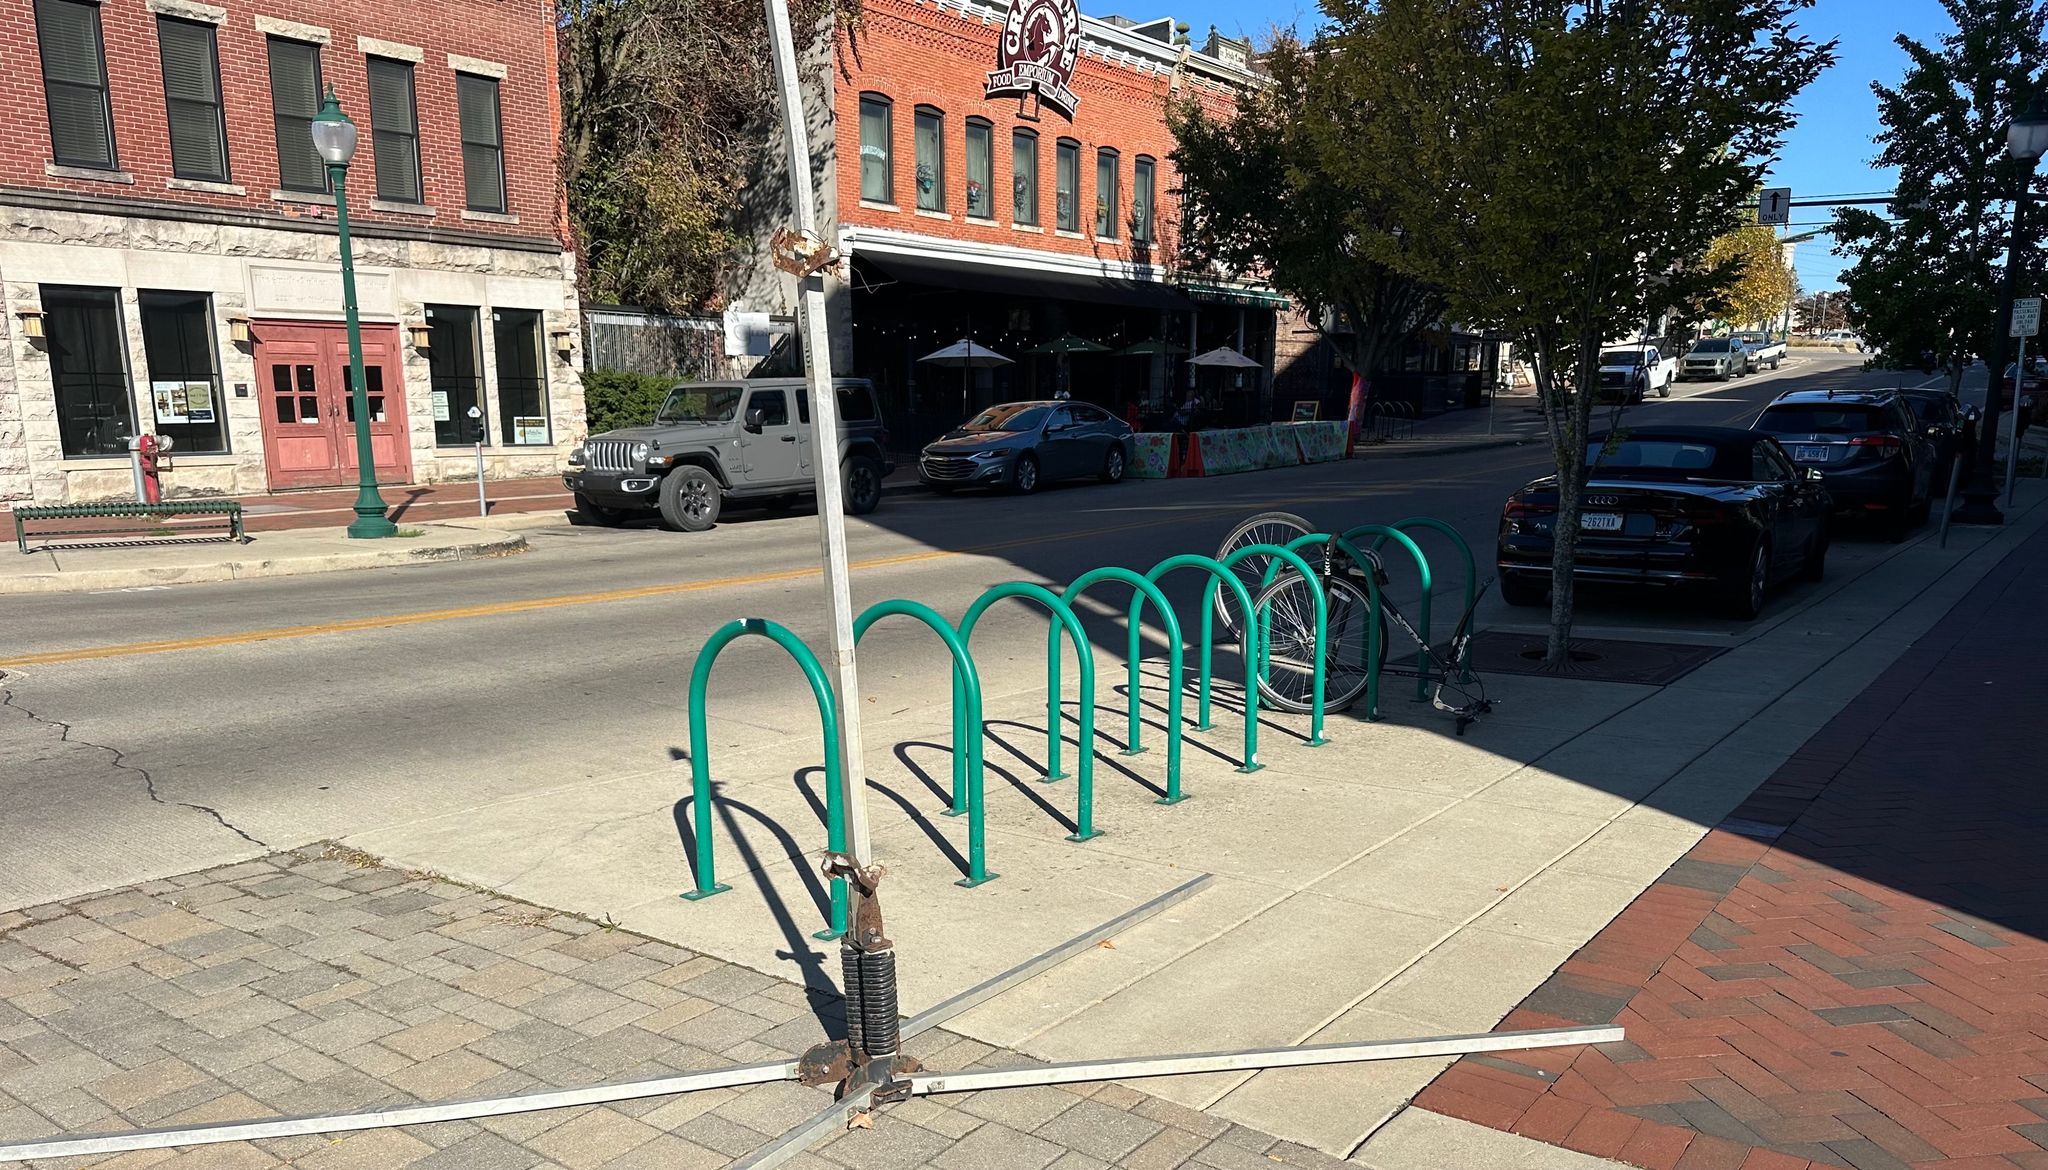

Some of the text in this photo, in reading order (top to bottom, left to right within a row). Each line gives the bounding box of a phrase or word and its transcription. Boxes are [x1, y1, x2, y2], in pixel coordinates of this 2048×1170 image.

[1006, 0, 1037, 55] CRA
[1051, 0, 1079, 72] ORSE
[992, 73, 1011, 88] FOOD
[1018, 64, 1055, 85] EMPORIUM
[1057, 88, 1076, 110] DRINK
[1762, 213, 1784, 221] ONLY
[1587, 516, 1616, 528] 262TXA
